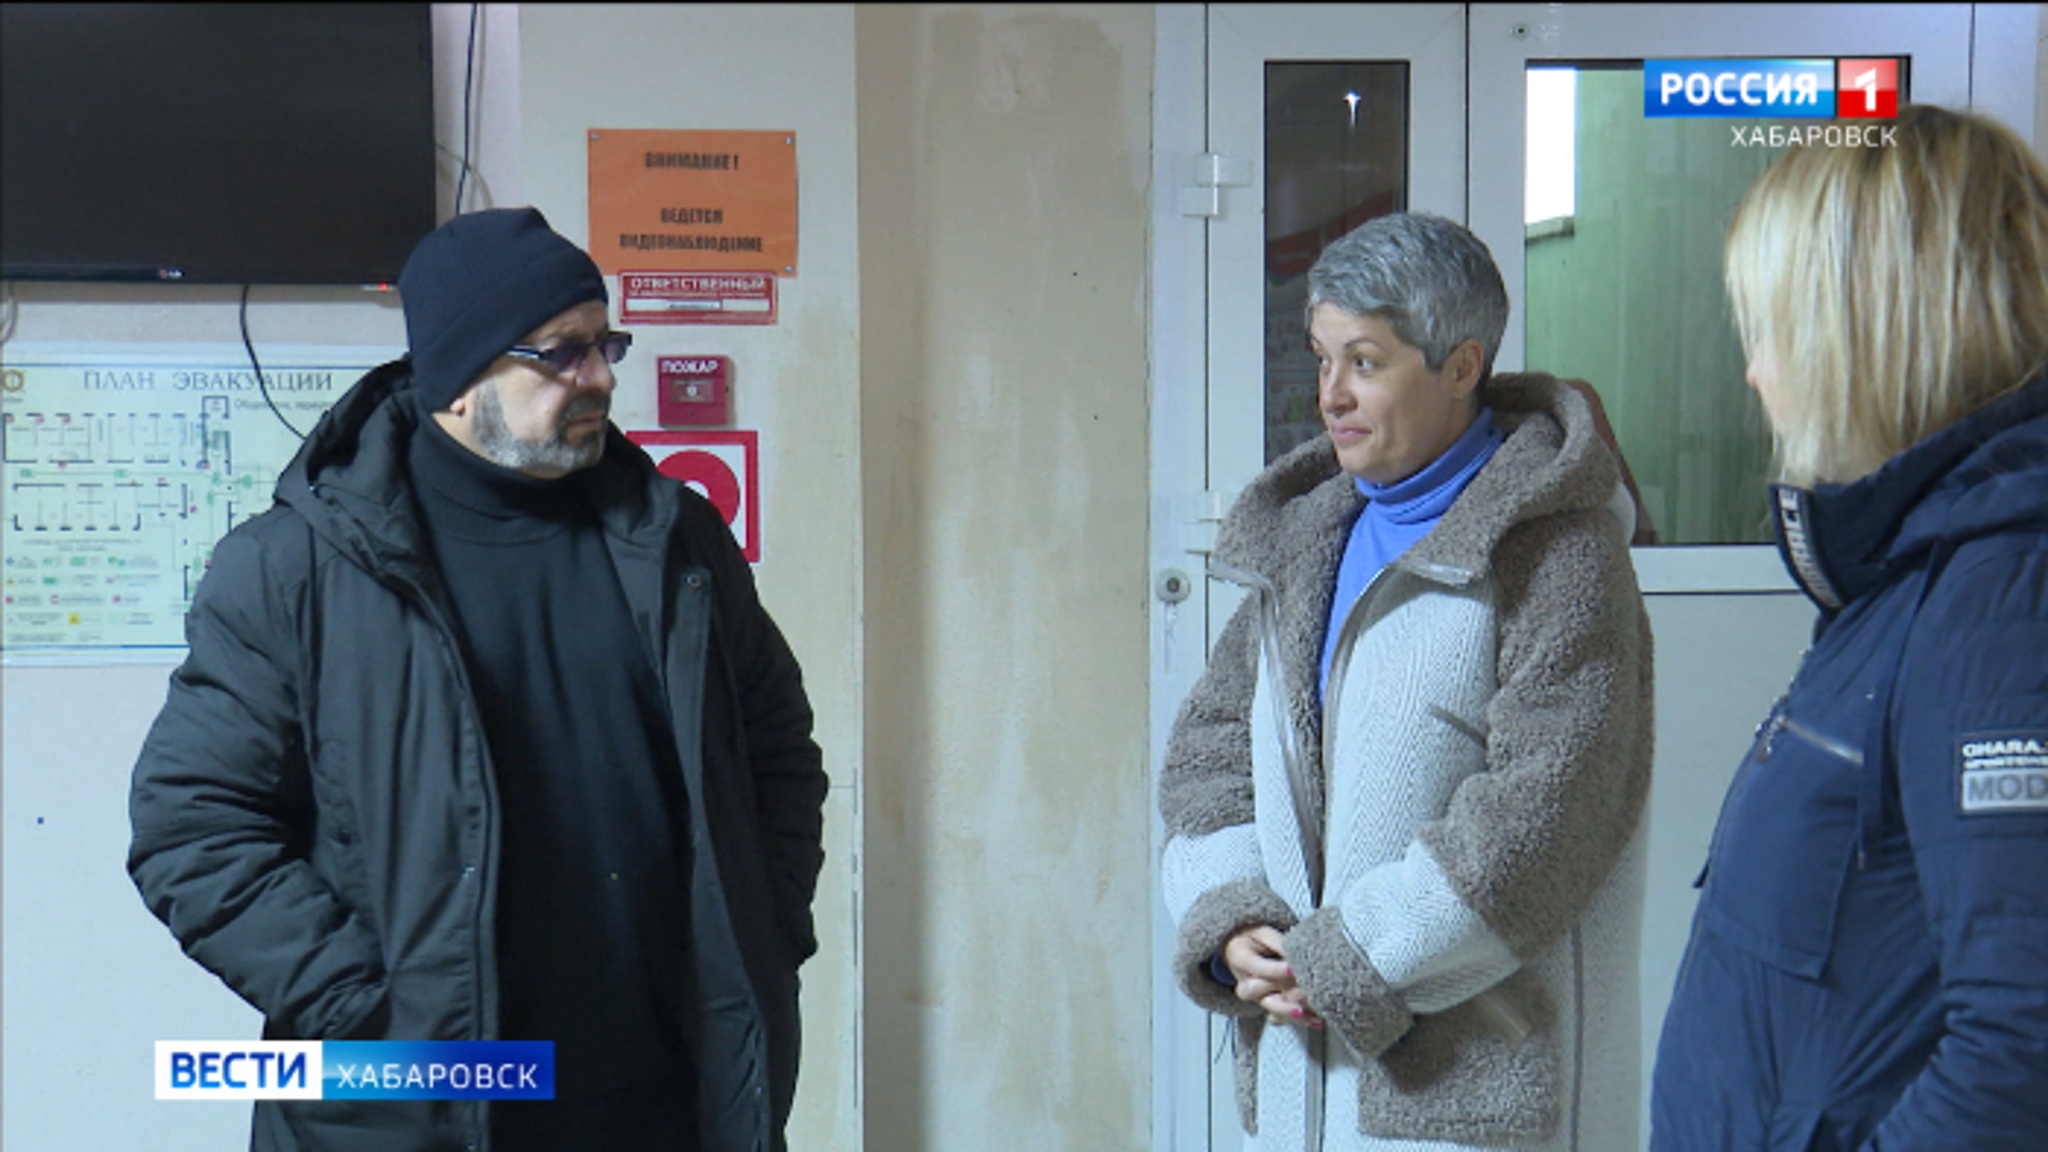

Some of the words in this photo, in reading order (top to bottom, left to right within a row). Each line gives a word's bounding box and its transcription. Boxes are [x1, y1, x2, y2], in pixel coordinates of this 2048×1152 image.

[645, 152, 730, 170] ВНИМАНИЕ
[660, 208, 724, 225] ВЕДЕТСЯ
[630, 276, 766, 291] ОТВЕТСТВЕННЫЙ
[661, 359, 719, 374] ПОЖАР
[83, 371, 155, 391] ПЛАН
[172, 371, 333, 393] ЭВАКУАЦИИ
